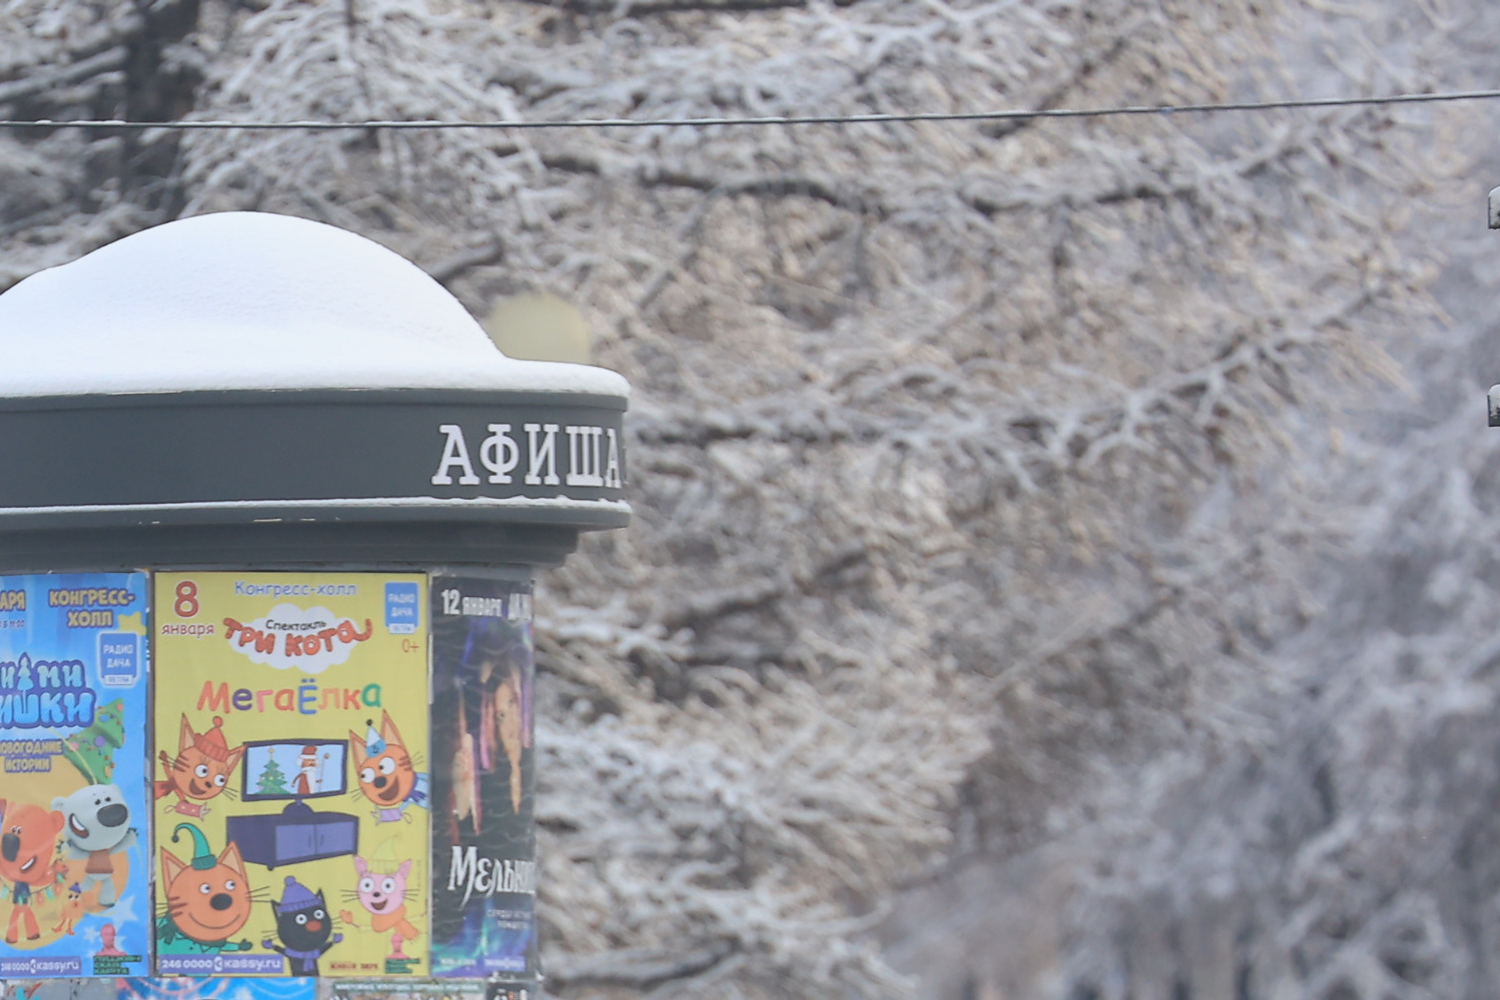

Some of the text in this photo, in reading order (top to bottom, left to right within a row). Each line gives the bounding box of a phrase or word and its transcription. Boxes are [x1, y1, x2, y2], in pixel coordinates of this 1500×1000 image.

[431, 424, 622, 489] АФИША
[48, 588, 135, 607] КОНГРЕСС-
[174, 580, 199, 617] 8
[235, 581, 357, 599] Конгресс-холл
[441, 589, 460, 615] 12
[67, 611, 113, 629] ХОЛЛ
[161, 624, 214, 636] января
[265, 619, 327, 635] Спектакль
[223, 617, 373, 656] ТРИ КОТА
[197, 678, 382, 715] МегаЁлка
